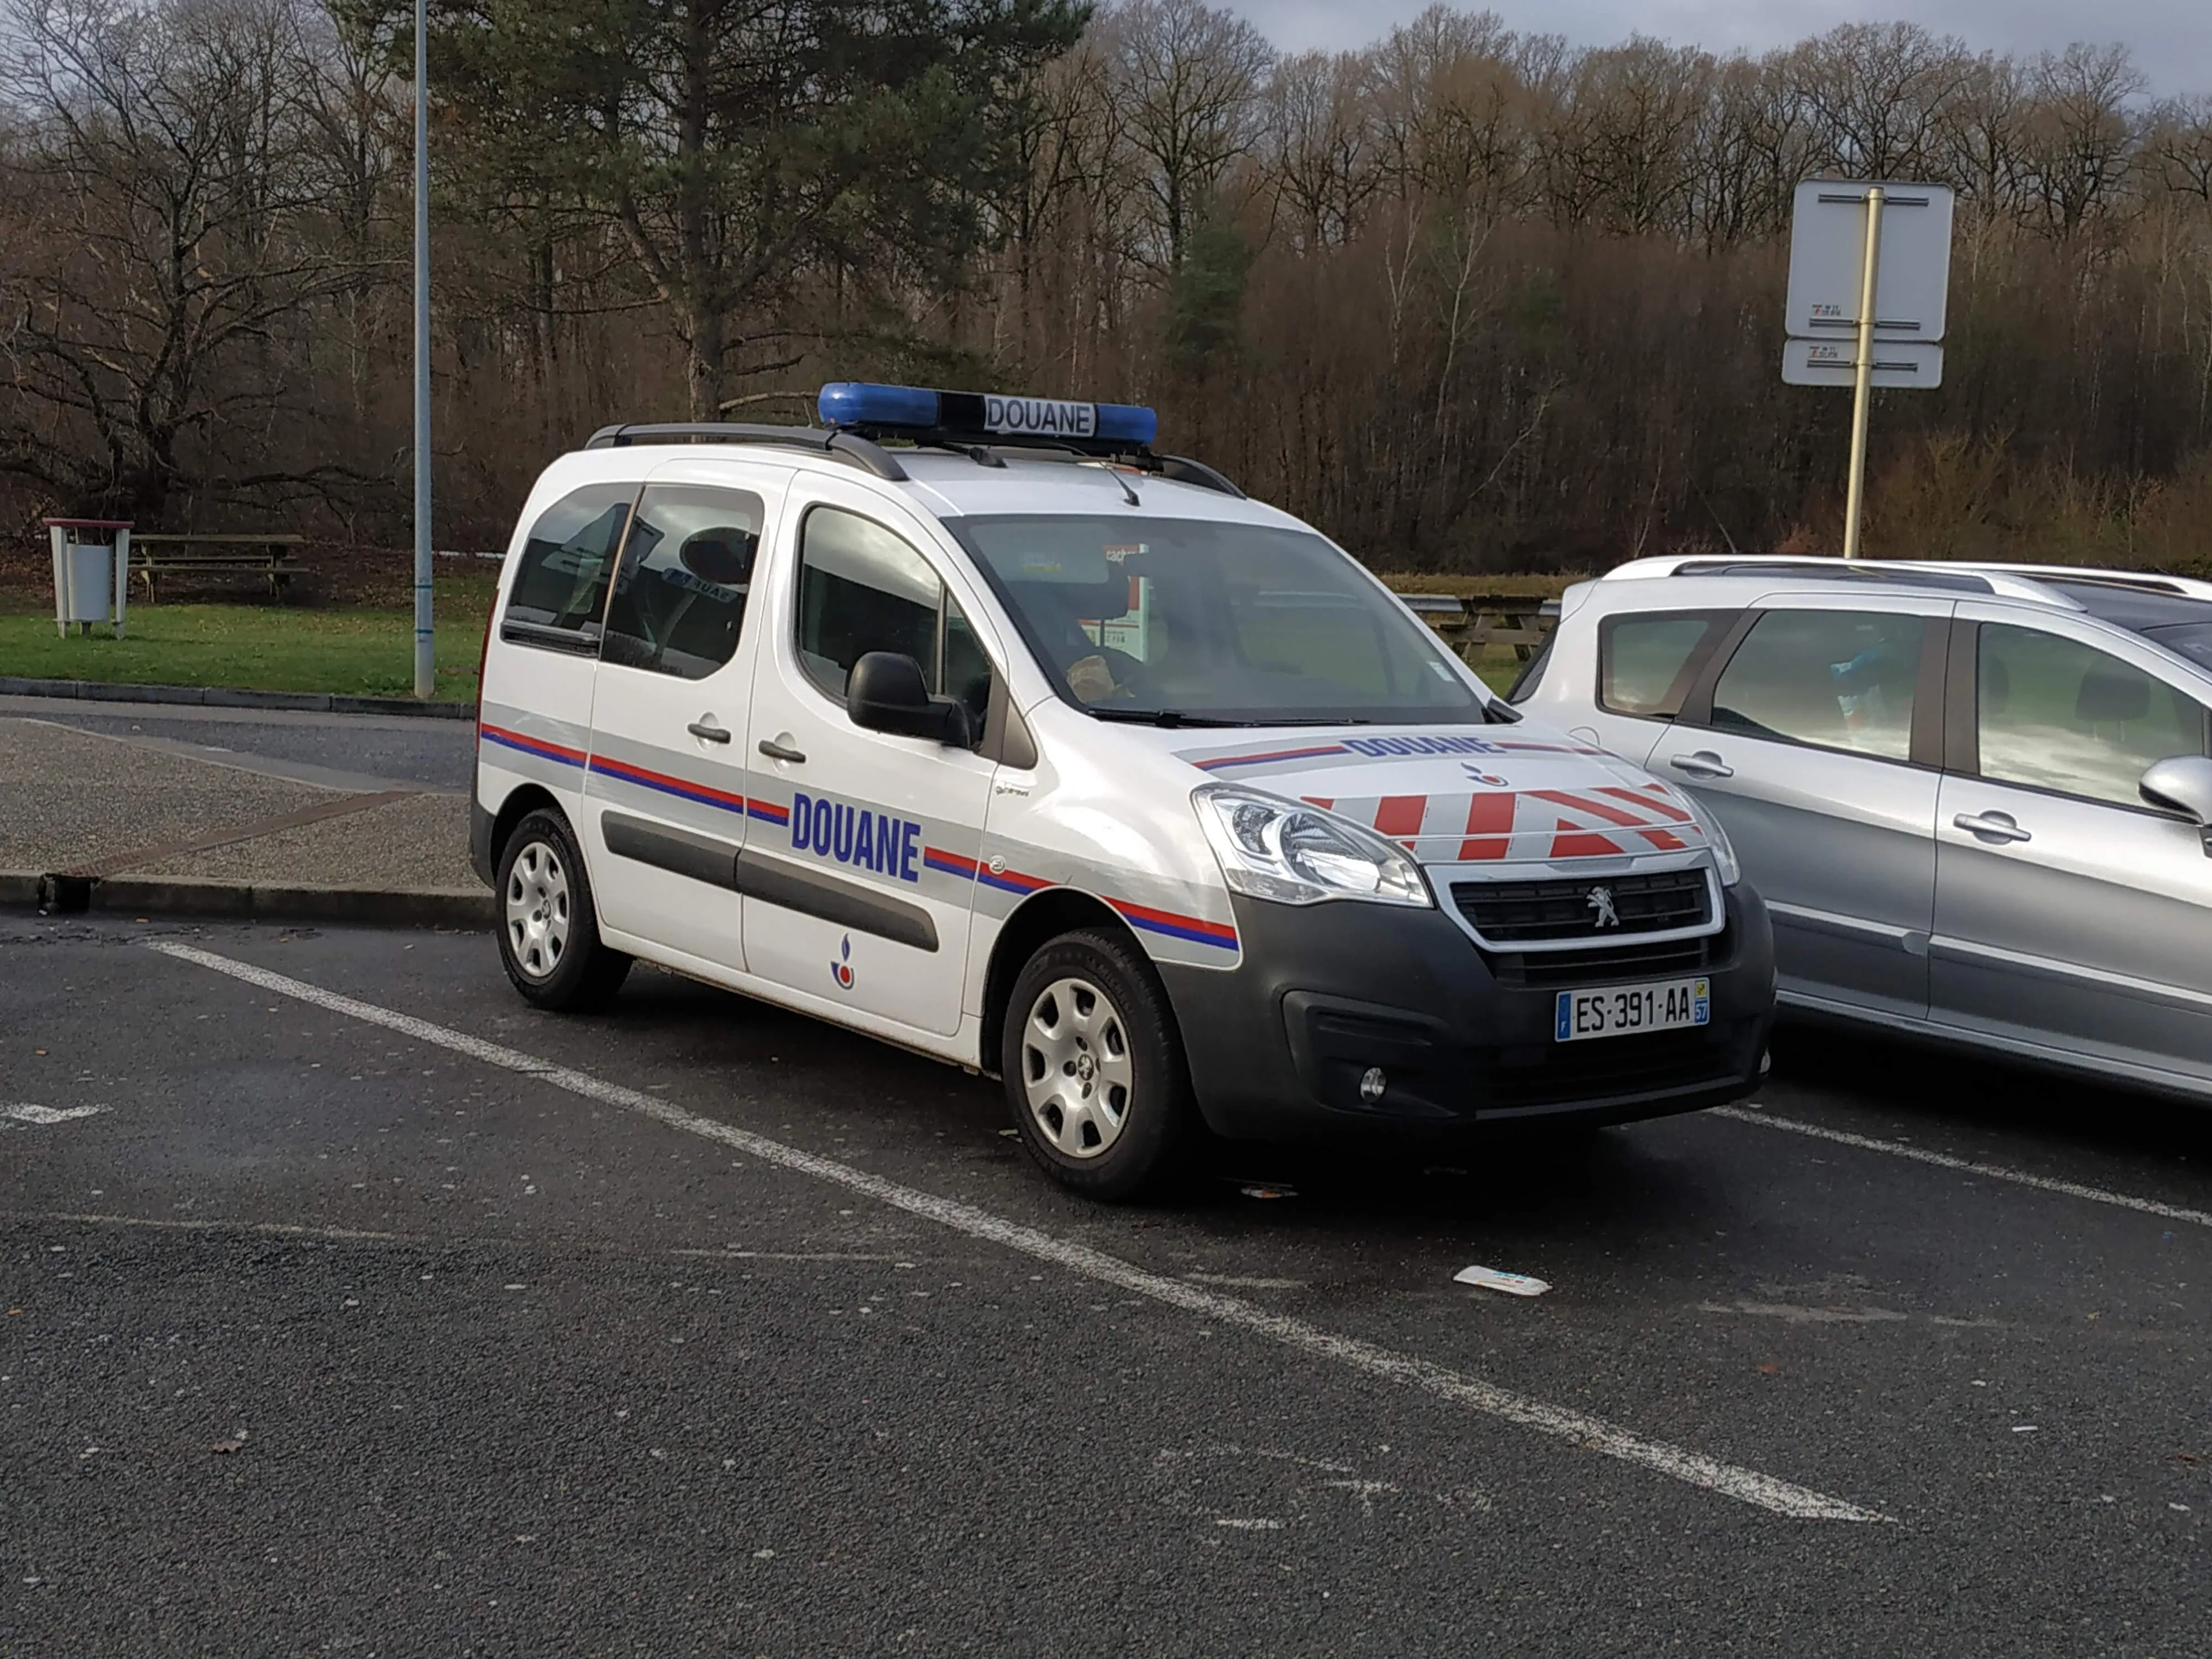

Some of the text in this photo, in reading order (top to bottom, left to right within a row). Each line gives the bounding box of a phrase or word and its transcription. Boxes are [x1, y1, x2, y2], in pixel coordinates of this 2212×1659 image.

[987, 398, 1090, 433] DOUANE
[1339, 737, 1508, 757] DOUANE
[791, 791, 921, 883] DOUANE
[1695, 1003, 1707, 1020] 57
